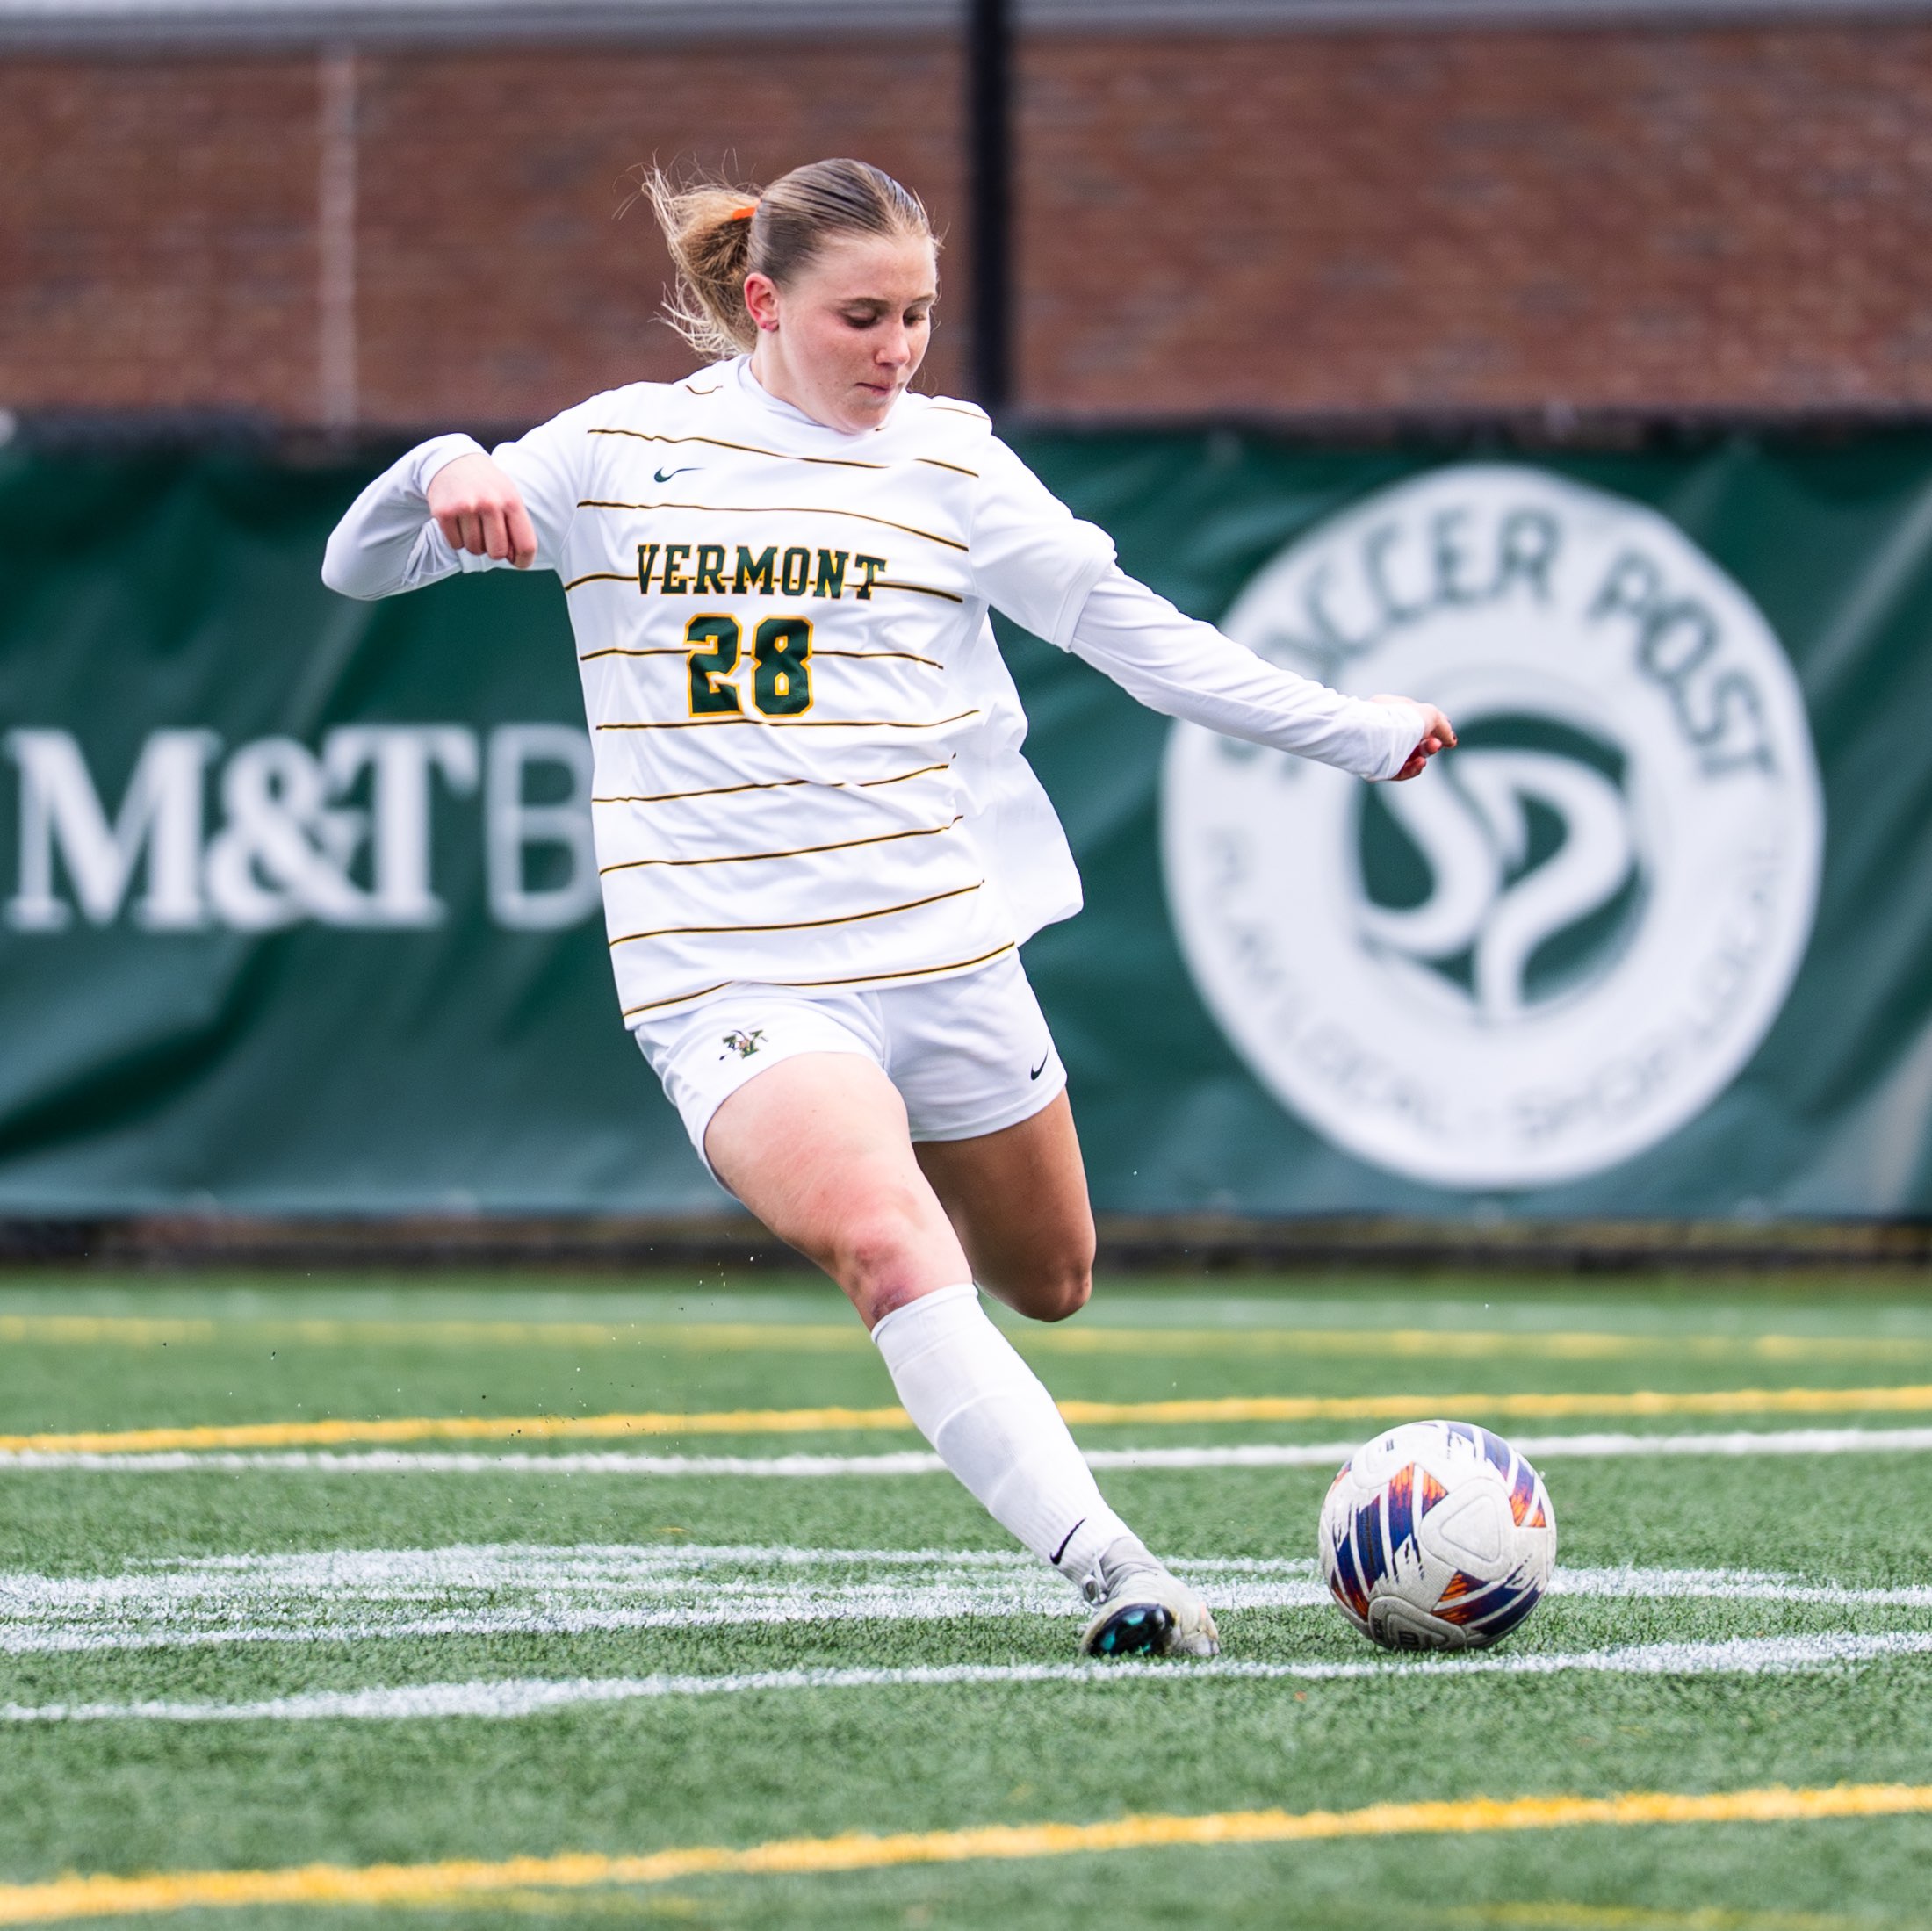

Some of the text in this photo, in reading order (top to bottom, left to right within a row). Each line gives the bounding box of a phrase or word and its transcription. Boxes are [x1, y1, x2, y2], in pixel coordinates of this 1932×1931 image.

[637, 543, 887, 601] VERMONT
[682, 612, 814, 718] 28
[1587, 546, 1780, 786] POST
[4, 724, 479, 933] M&T
